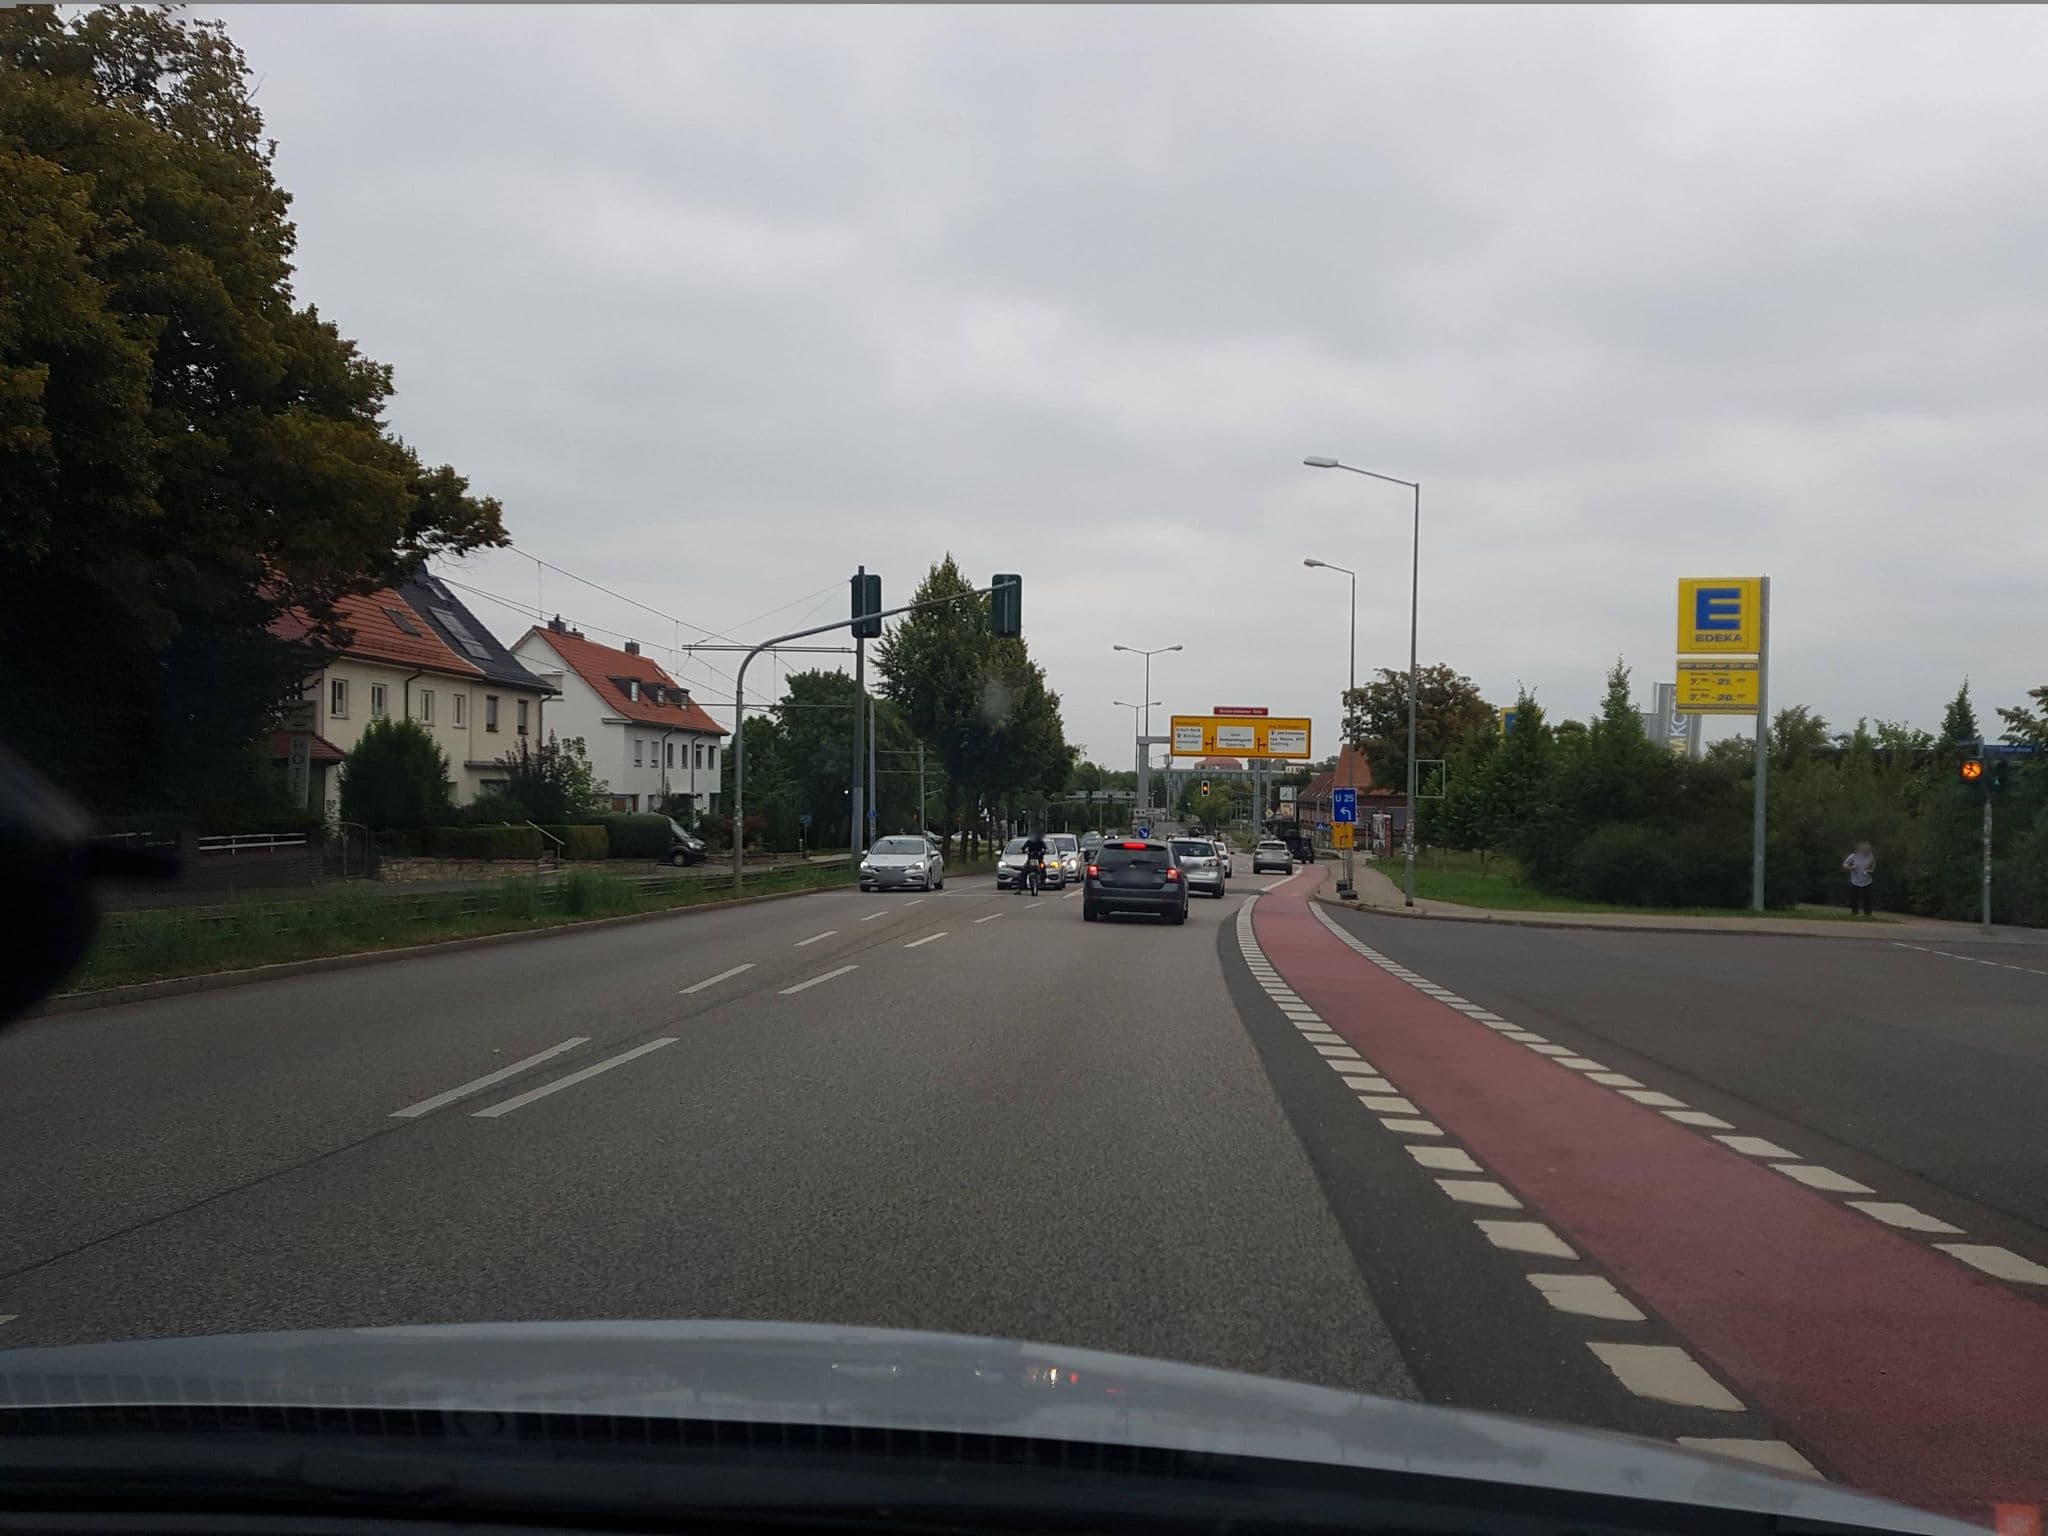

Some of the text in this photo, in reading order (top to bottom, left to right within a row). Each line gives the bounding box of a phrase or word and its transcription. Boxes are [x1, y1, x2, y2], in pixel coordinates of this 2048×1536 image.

[1696, 588, 1741, 630] E
[1696, 633, 1742, 642] EDEKA
[1335, 793, 1355, 803] U 25
